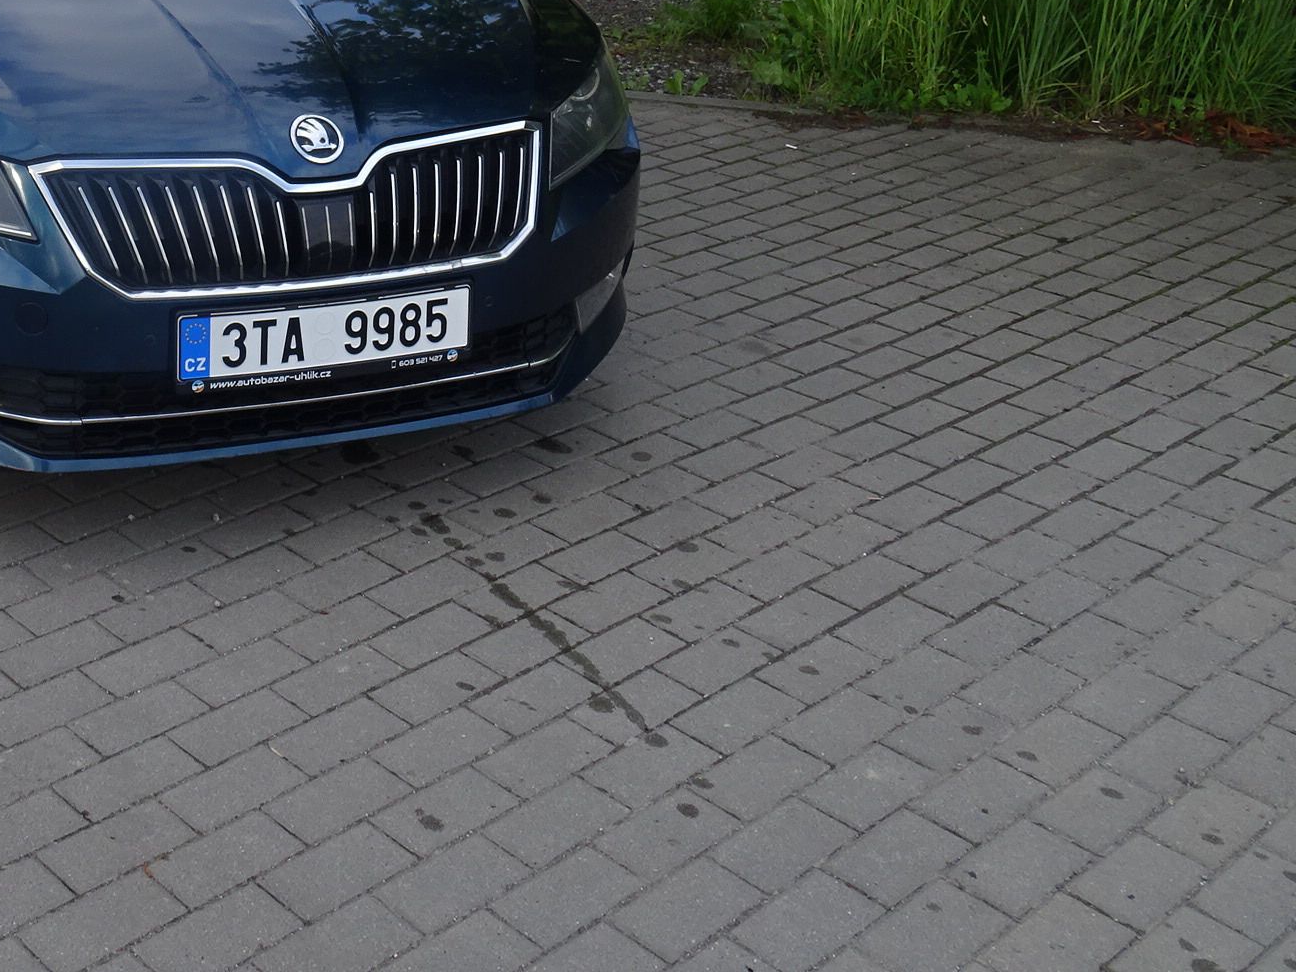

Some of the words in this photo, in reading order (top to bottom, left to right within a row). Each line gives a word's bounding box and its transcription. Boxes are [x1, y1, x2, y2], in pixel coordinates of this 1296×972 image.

[221, 316, 305, 369] 3TA
[344, 297, 449, 355] 9985
[184, 356, 207, 373] CZ
[209, 370, 332, 390] www.autobazar-uhlik.cz
